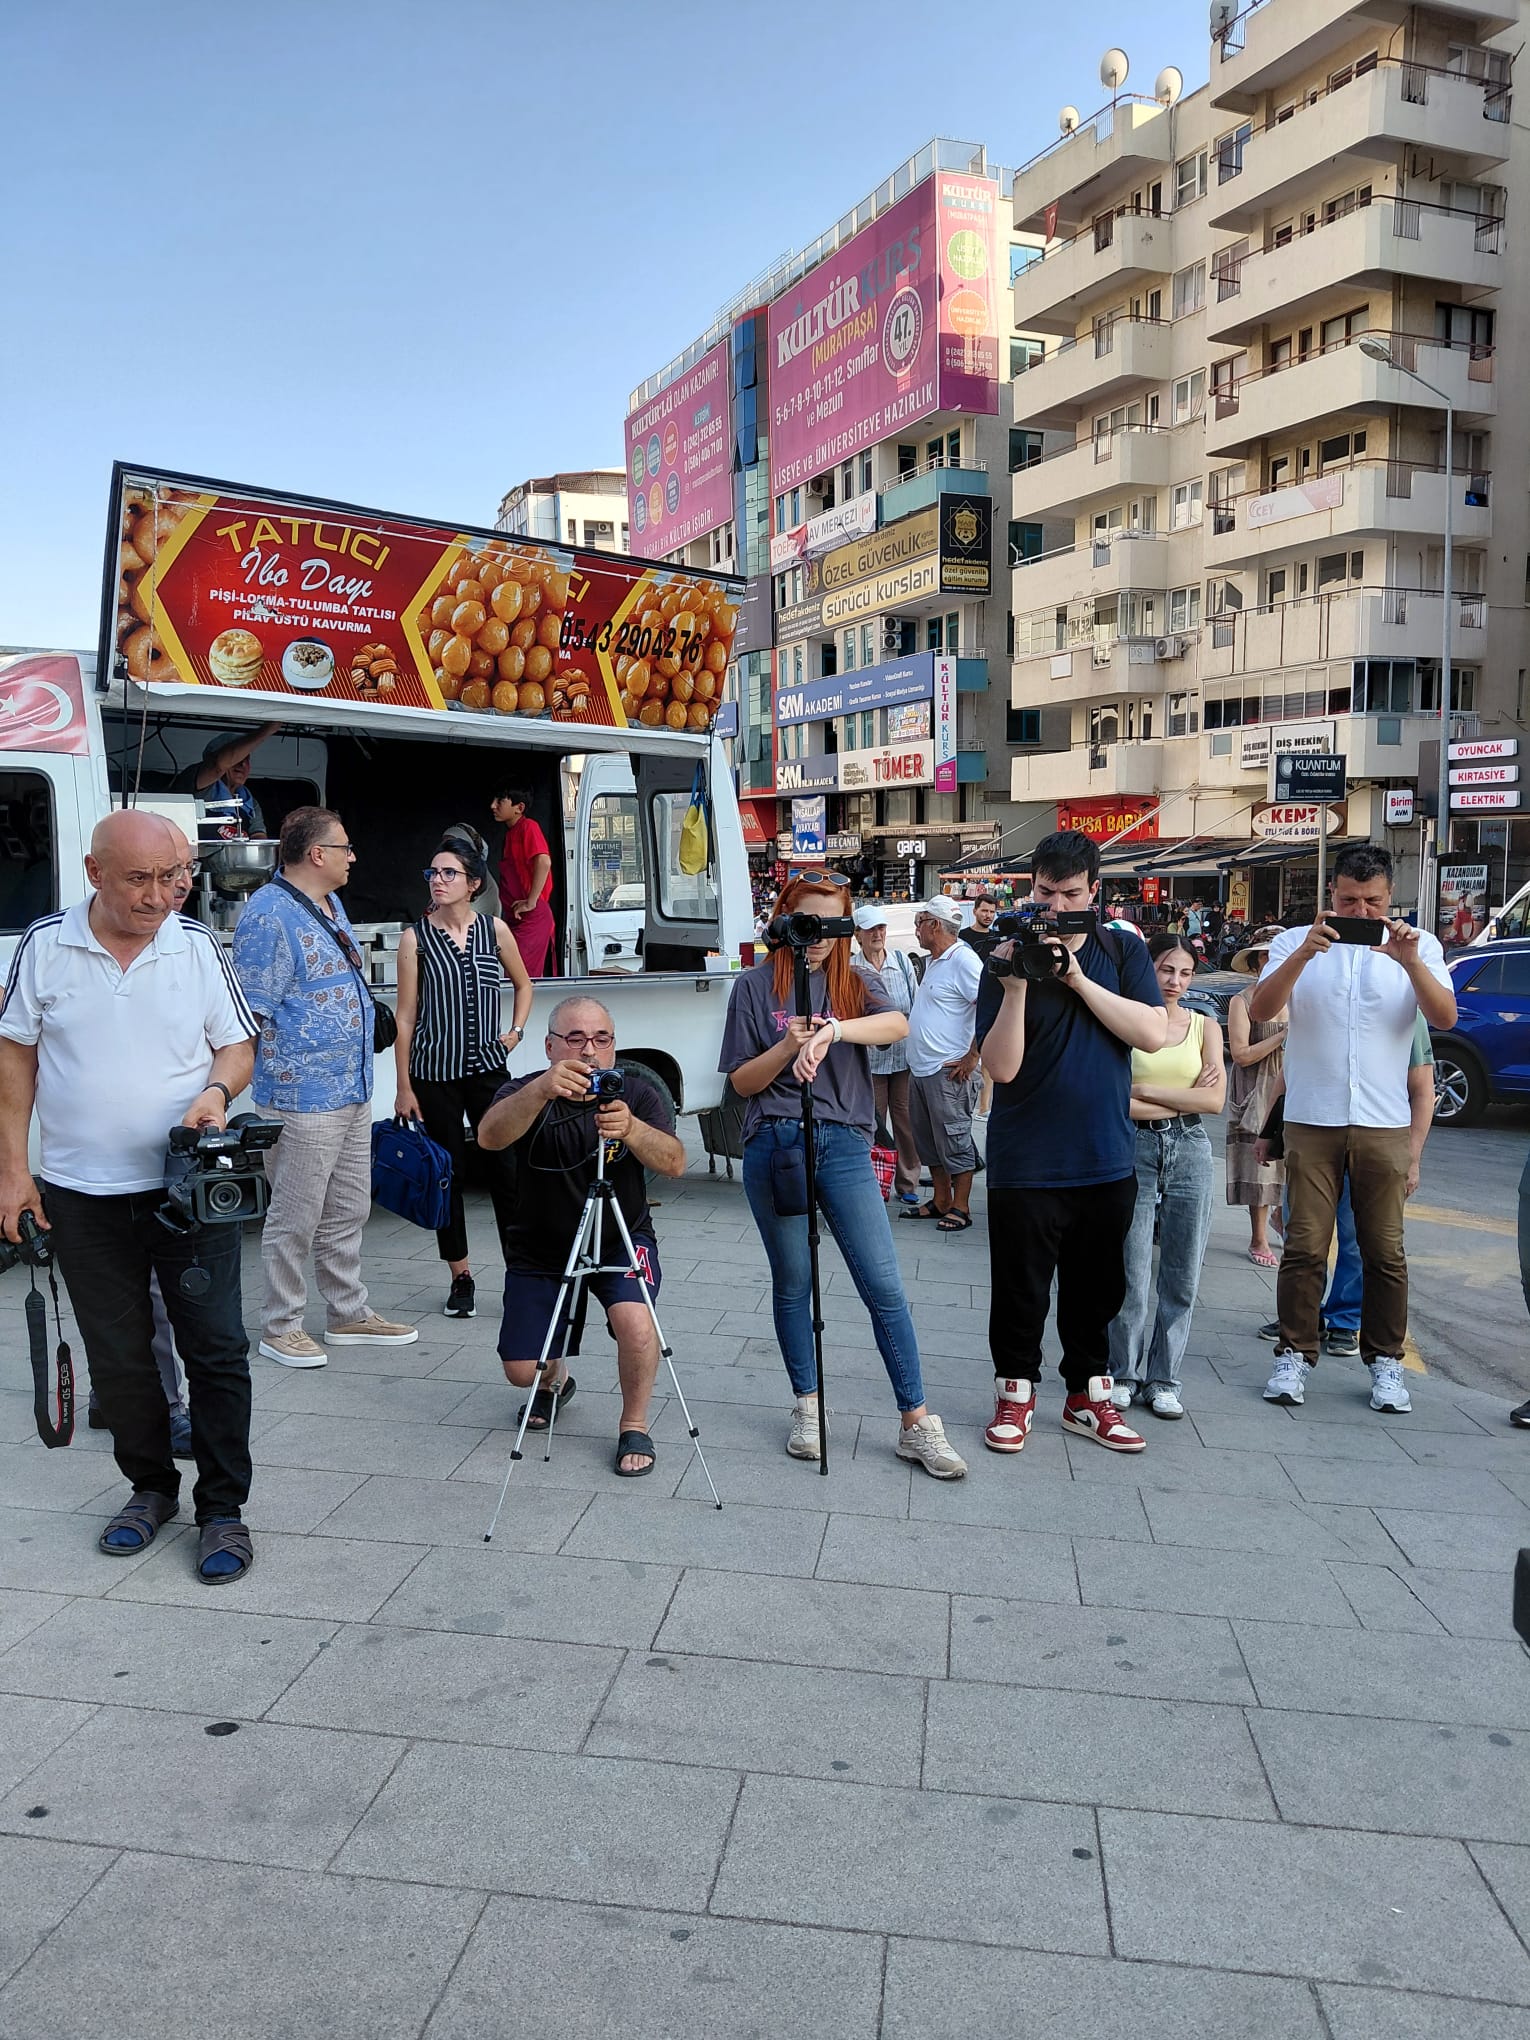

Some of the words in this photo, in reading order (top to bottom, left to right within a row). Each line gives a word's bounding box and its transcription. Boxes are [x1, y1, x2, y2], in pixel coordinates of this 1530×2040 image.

[860, 226, 921, 305] KURS
[811, 301, 878, 375] (MURATPAŞA)
[898, 341, 908, 354] YIL
[846, 342, 880, 380] Sınıflar
[673, 380, 690, 409] OLAN
[690, 357, 719, 398] KAZANIR!
[816, 391, 843, 424] Mezun
[774, 460, 801, 490] LİSEYE
[803, 453, 813, 473] ve
[815, 411, 881, 467] ÜNİVERSİTEYE
[884, 381, 933, 427] HAZIRLIK
[822, 503, 858, 537] MERKEZİ
[216, 517, 390, 571] TATLICI
[240, 546, 288, 587] İbo
[825, 564, 855, 587] ÖZEL
[858, 532, 921, 573] GÜVENLİK
[944, 566, 958, 574] özel
[826, 583, 870, 620] sürücü
[876, 566, 934, 603] kursları
[352, 605, 396, 621] TATLISI
[312, 617, 372, 634] KAVURMA
[804, 690, 843, 716] AKADEMİ
[941, 724, 949, 759] KURS
[1276, 737, 1292, 749] DİŞ
[1457, 743, 1503, 757] OYUNCAK
[1295, 759, 1341, 771] KUANTUM
[1457, 768, 1506, 782] KIRTASİYE
[1390, 797, 1412, 808] Birim
[1460, 793, 1506, 805] ELEKTRİK
[1271, 807, 1318, 824] KENT
[1394, 809, 1408, 817] AVM
[795, 821, 820, 834] AYAKKABI
[1294, 827, 1300, 836] &
[827, 837, 838, 848] EFE
[838, 836, 860, 850] ÇANTA
[896, 839, 926, 858] garaj
[1446, 866, 1484, 879] KAZANDIRAN
[623, 1244, 655, 1286] A
[61, 1363, 71, 1386] EOS
[62, 1387, 71, 1400] 5D
